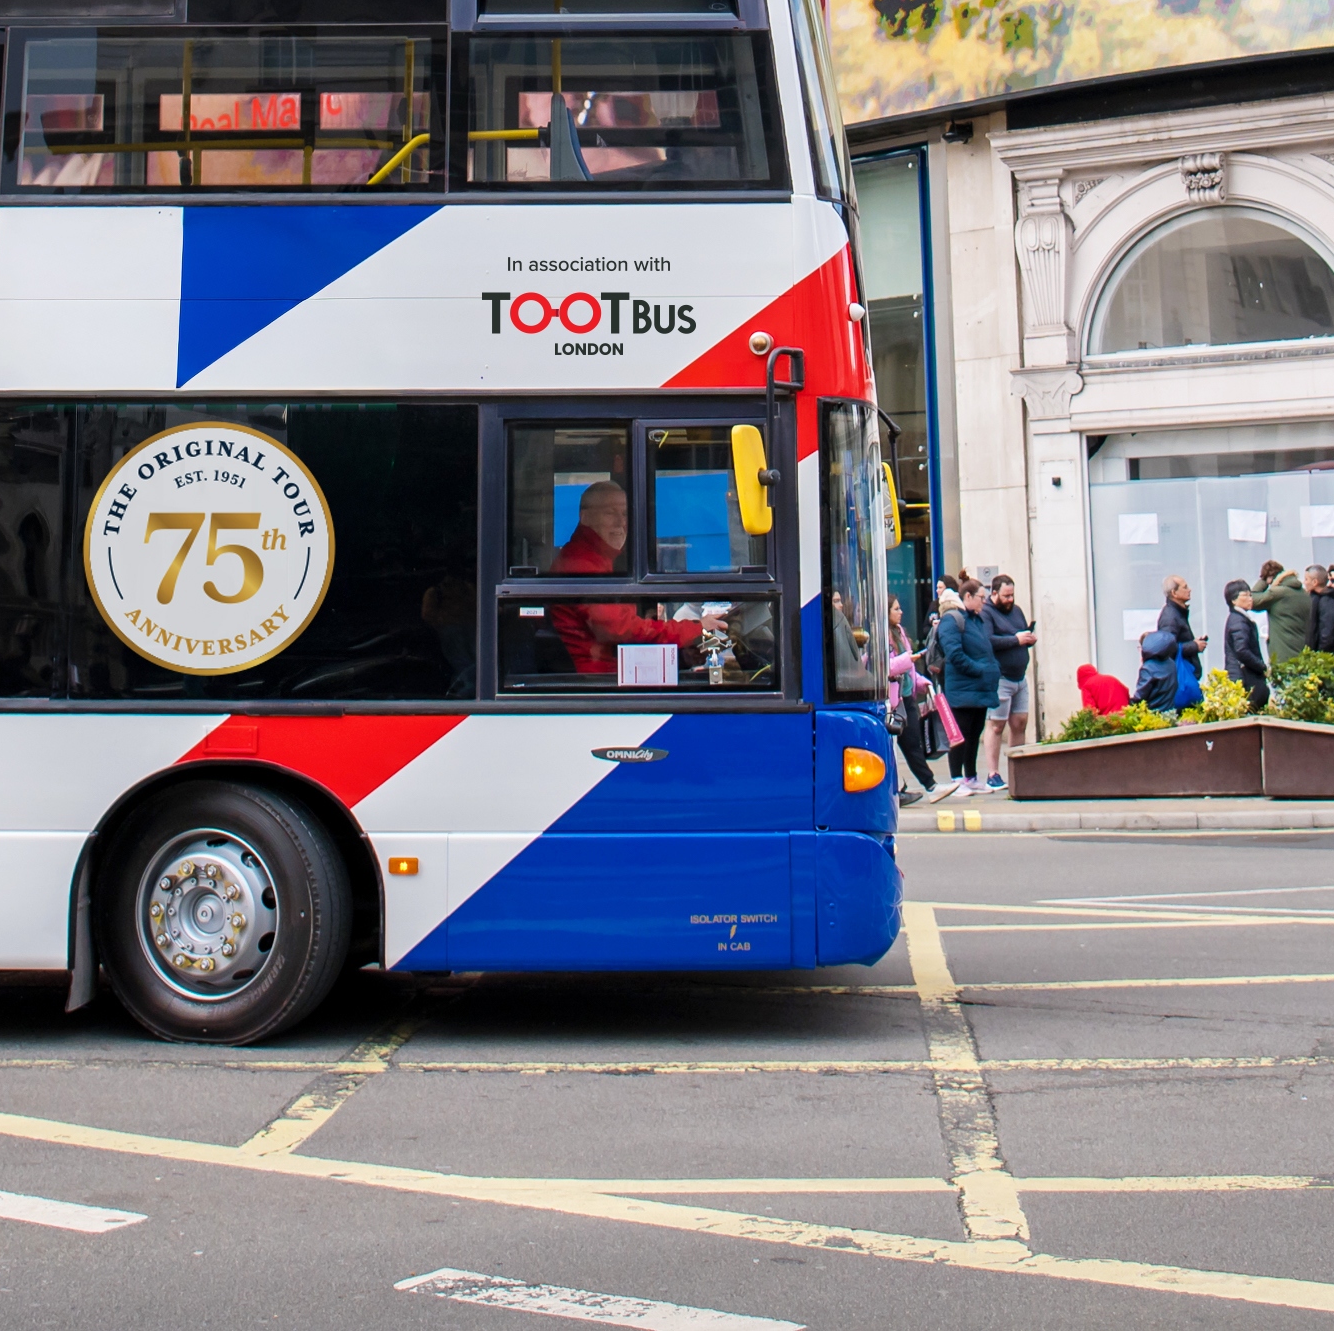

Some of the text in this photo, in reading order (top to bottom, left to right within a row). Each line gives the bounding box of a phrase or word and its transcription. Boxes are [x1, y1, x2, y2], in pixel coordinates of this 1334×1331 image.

[507, 256, 671, 272] In association with
[554, 342, 624, 356] LONDON
[173, 469, 247, 489] EST. 1951
[103, 439, 315, 538] THE ORIGINAL TOUR
[123, 604, 291, 656] ANNIVERSARY
[690, 914, 778, 924] ISOLATOR SWITCH
[717, 942, 751, 951] IN CAB
